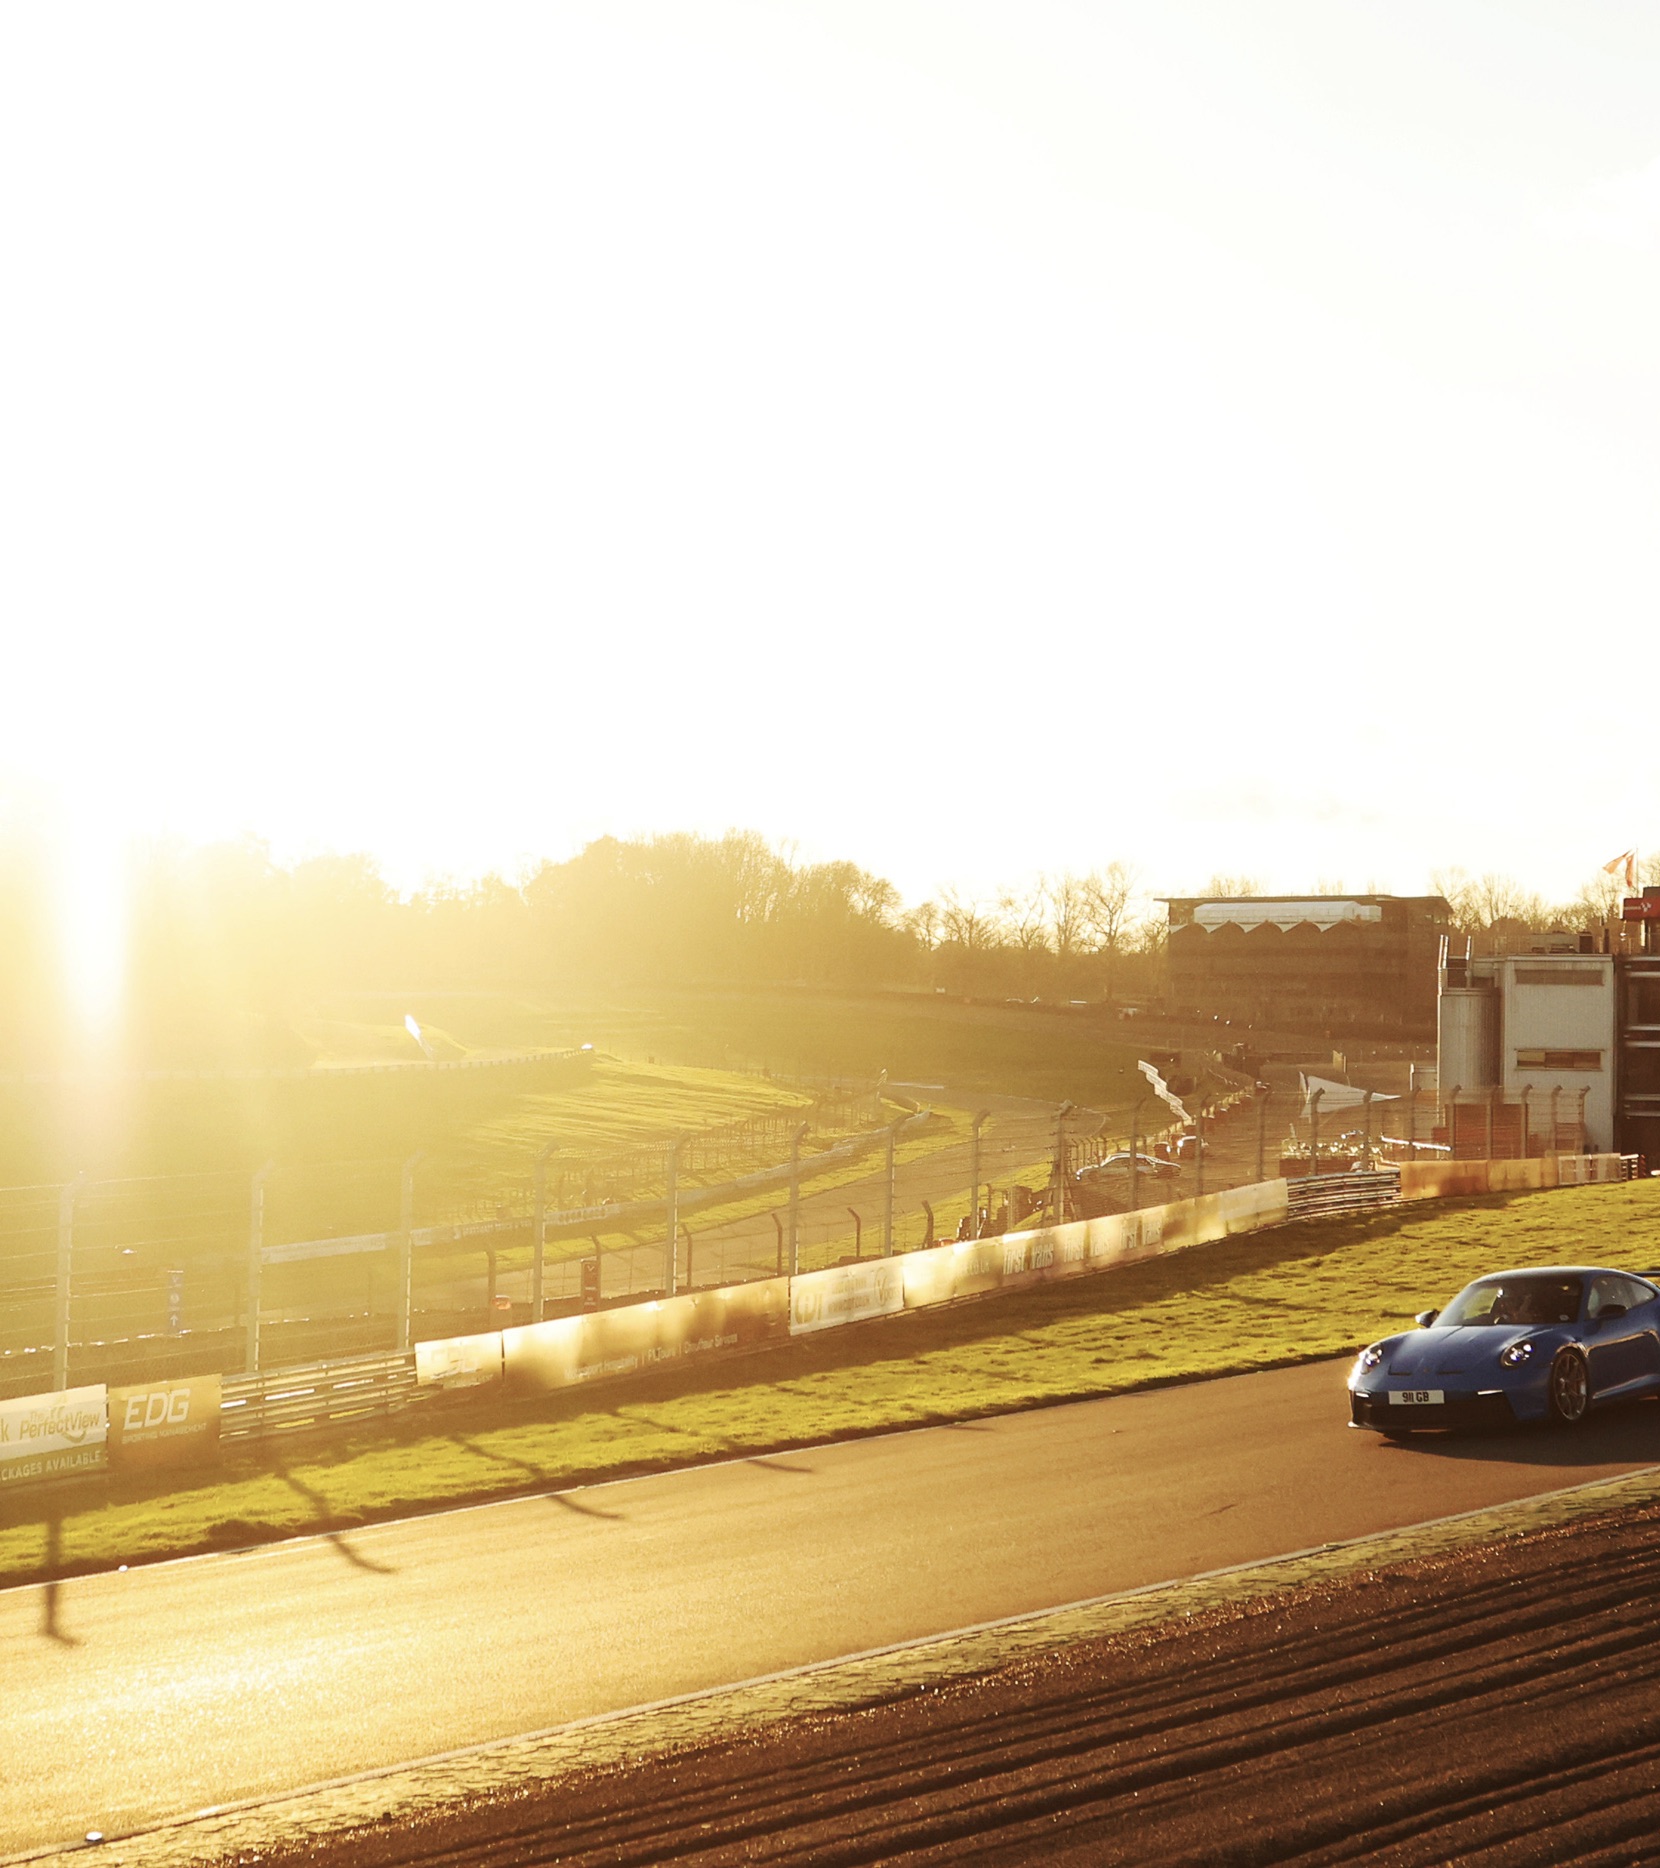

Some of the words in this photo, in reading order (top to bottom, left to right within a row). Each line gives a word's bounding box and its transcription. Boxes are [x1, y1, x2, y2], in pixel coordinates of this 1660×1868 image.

[123, 1388, 190, 1431] EDG
[1402, 1392, 1414, 1402] 911
[1416, 1391, 1429, 1402] GB
[20, 1411, 100, 1441] PerfectView
[0, 1461, 42, 1481] CKAGES
[46, 1450, 101, 1473] AVAILABLE
